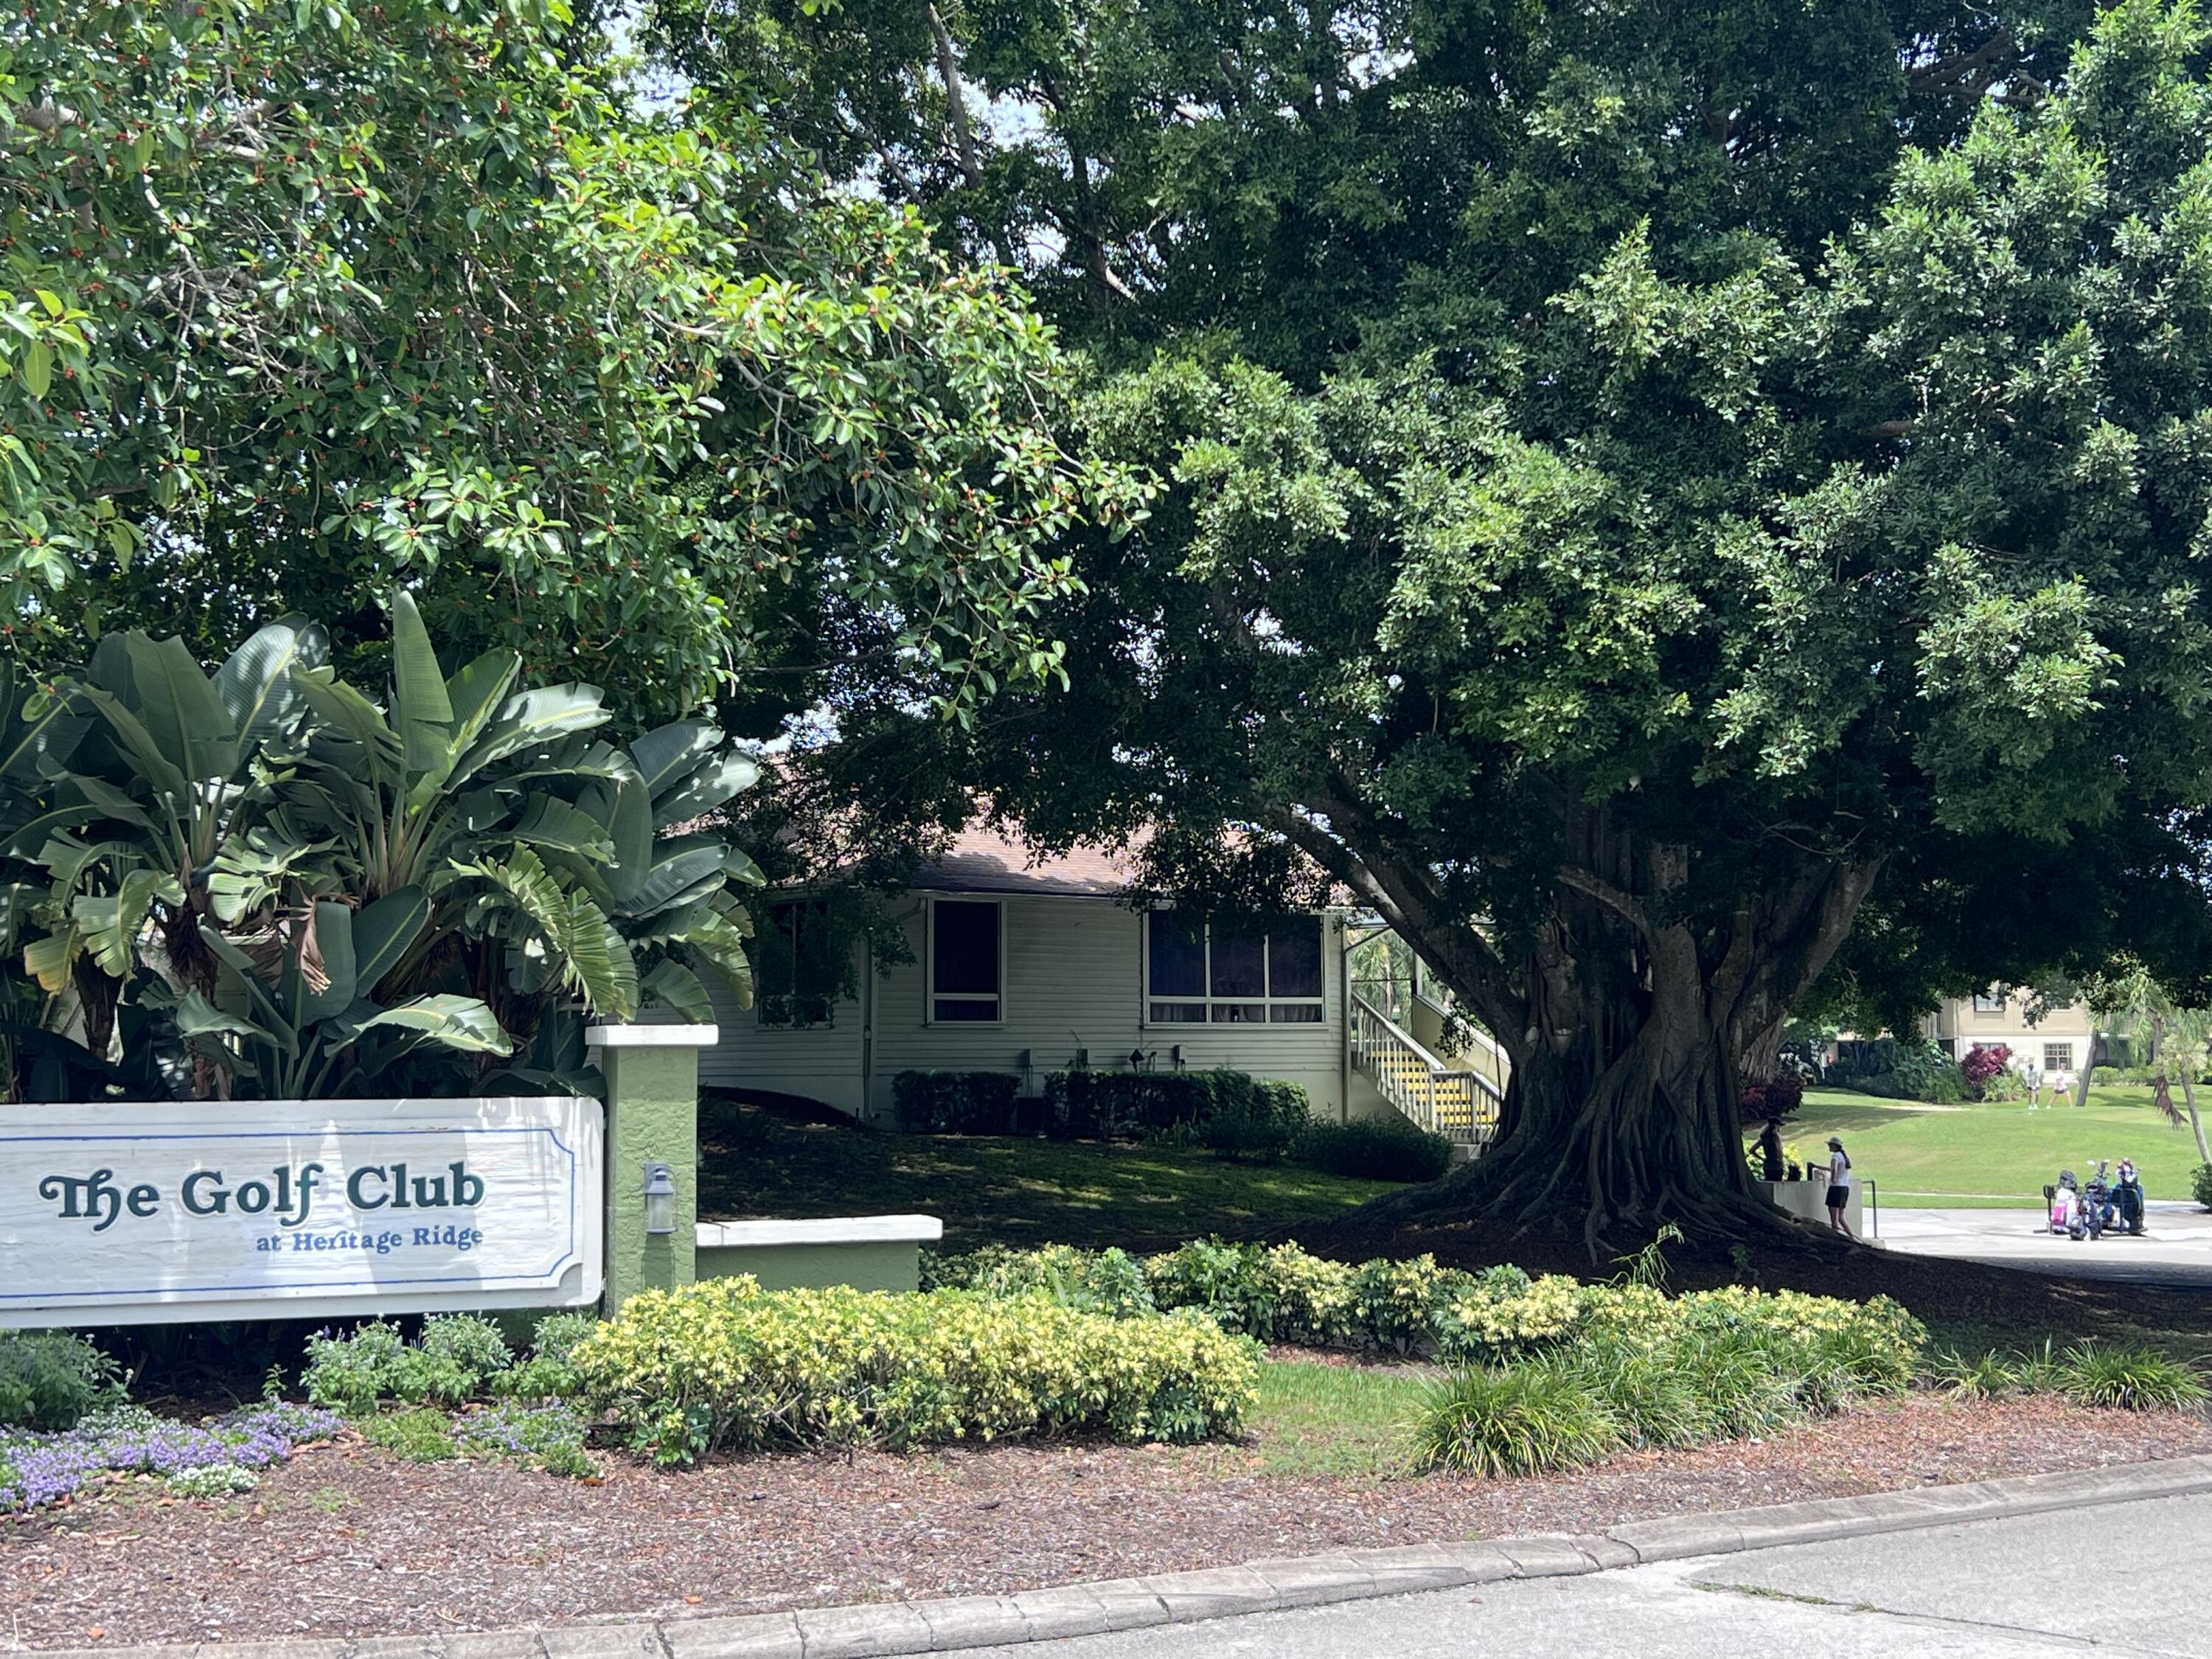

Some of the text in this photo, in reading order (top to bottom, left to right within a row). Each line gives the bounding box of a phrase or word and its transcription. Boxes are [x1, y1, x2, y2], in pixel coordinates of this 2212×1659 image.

[39, 1161, 485, 1231] The Golf Club
[257, 1225, 484, 1253] at Heritage Ridge
